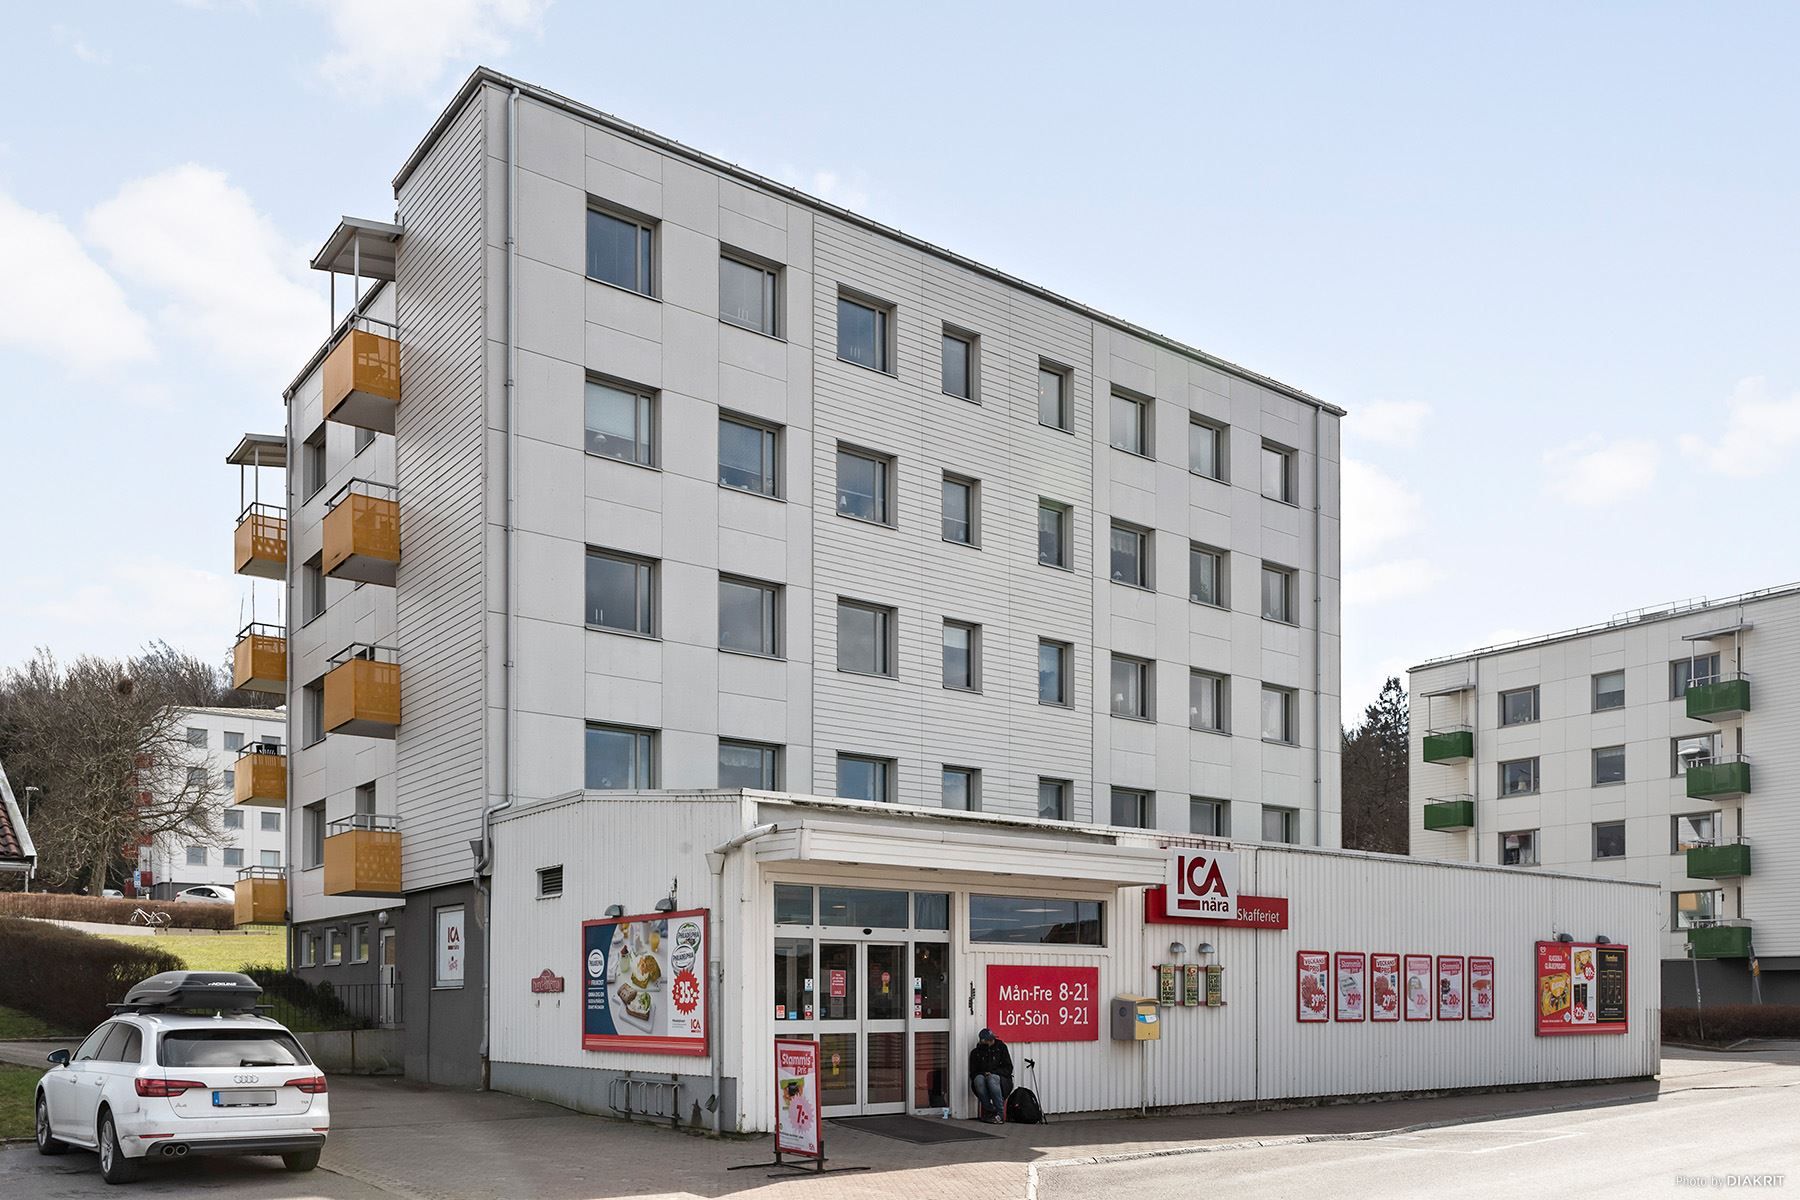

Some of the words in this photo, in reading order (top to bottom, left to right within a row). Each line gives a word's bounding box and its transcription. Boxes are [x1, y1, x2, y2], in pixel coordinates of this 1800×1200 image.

[1177, 855, 1229, 897] ICA
[1201, 897, 1229, 912] nära
[1237, 908, 1280, 923] Skafferiet
[447, 926, 460, 943] ICA
[672, 952, 695, 961] PHILADELPHIA
[1304, 957, 1325, 966] VECKANS
[1376, 959, 1396, 967] VECKANS
[1310, 964, 1321, 973] PRIS
[999, 984, 1053, 1001] Mån-Fre
[1059, 982, 1089, 1001] 8-21
[999, 1009, 1050, 1026] Lör-Sön
[1059, 1006, 1089, 1025] 9-21
[691, 1018, 701, 1030] ICA
[782, 1053, 812, 1066] Stammis
